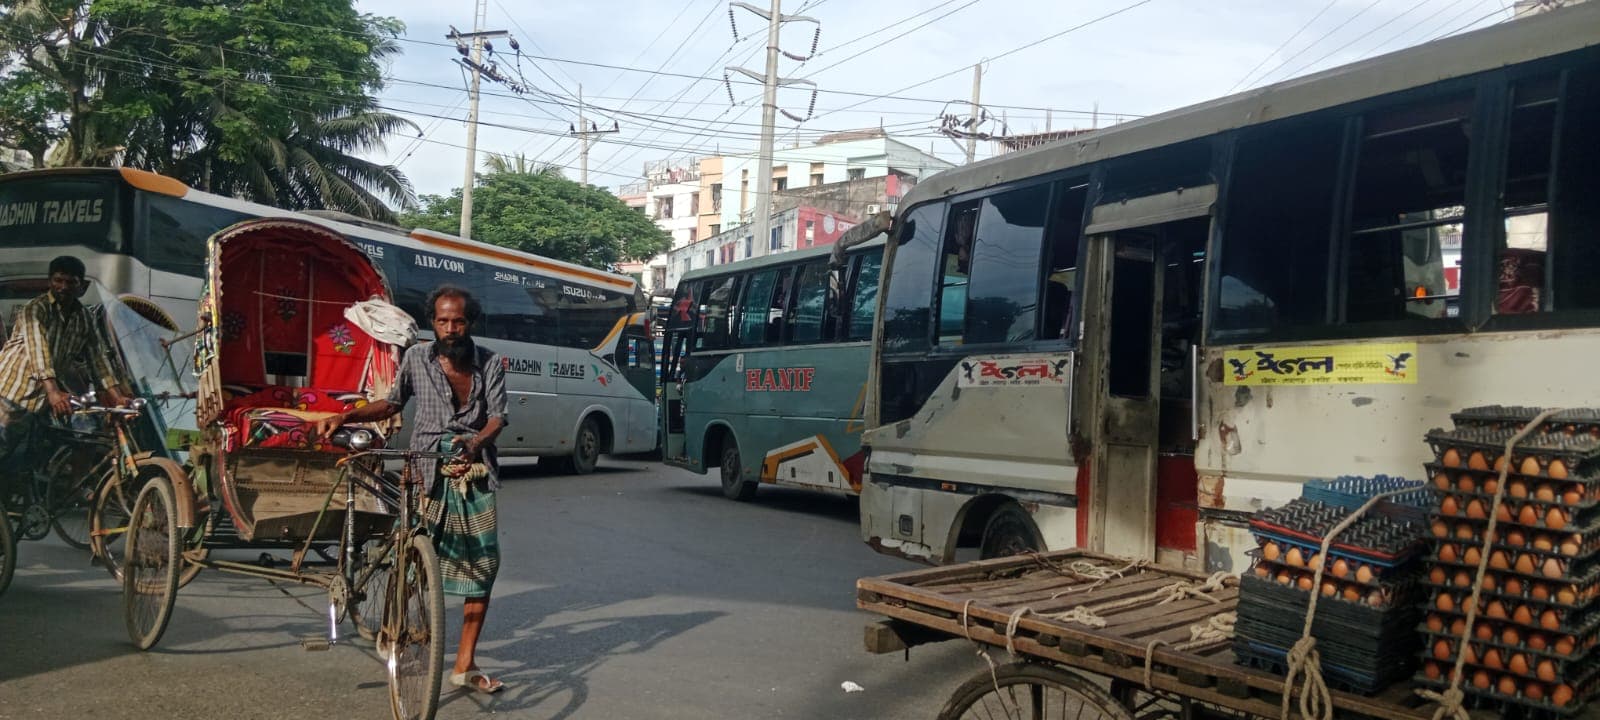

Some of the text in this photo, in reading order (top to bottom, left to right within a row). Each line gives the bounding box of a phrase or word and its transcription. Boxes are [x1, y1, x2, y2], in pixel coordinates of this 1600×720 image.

[42, 199, 104, 223] TRAVELS
[414, 254, 465, 274] AIR/CON
[501, 357, 585, 378] SHADHIN TRAVELS
[745, 367, 815, 392] HANIF
